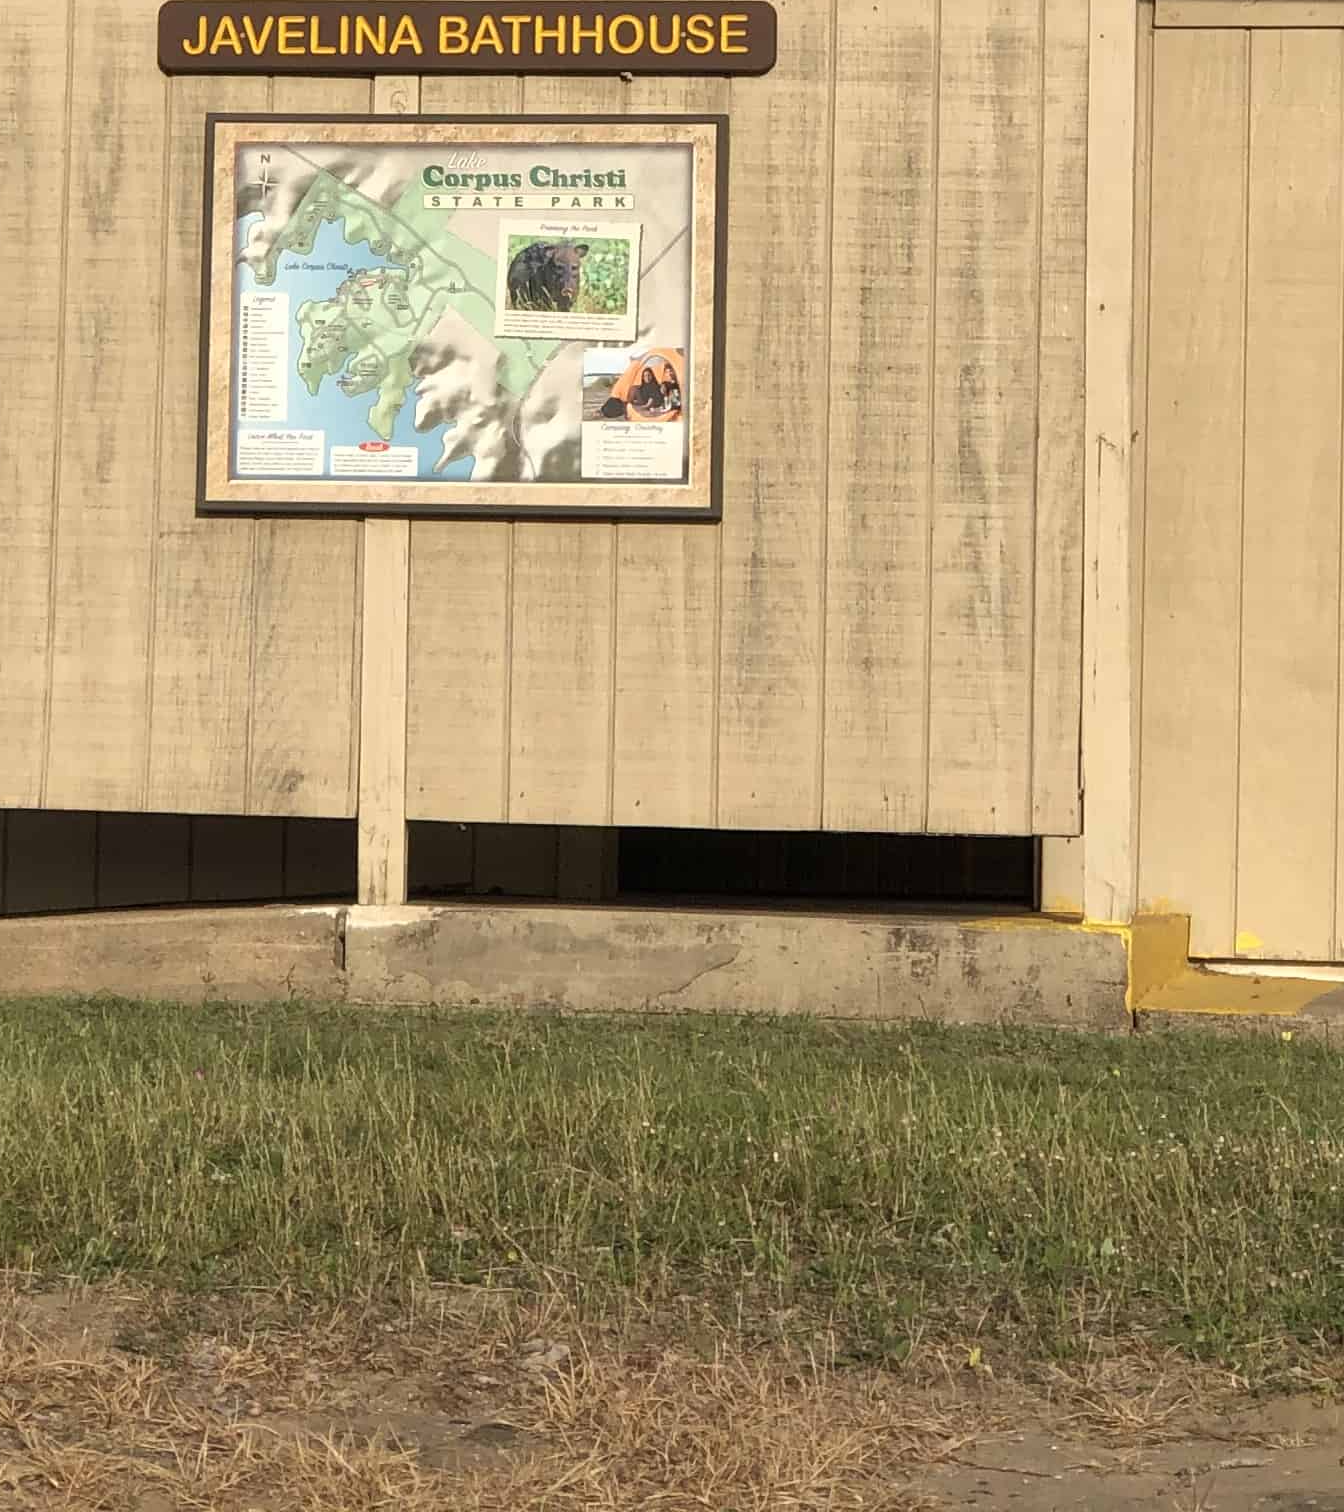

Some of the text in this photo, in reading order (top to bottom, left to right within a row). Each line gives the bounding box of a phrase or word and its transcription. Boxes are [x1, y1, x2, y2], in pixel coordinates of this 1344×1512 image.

[183, 14, 748, 55] JAVELINA BATHHOUSE
[261, 154, 271, 163] N
[447, 152, 487, 169] Lake
[423, 165, 626, 191] Corpus Christi
[431, 196, 626, 208] STATE PARK
